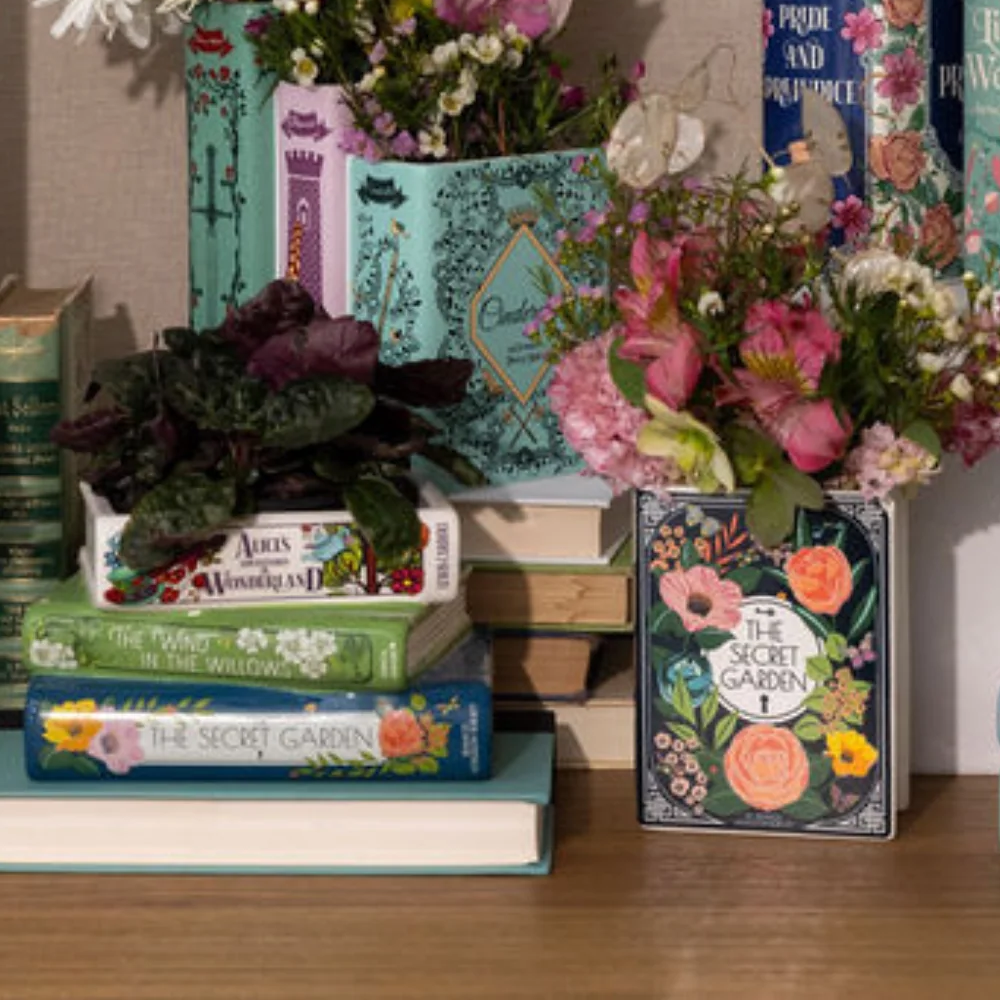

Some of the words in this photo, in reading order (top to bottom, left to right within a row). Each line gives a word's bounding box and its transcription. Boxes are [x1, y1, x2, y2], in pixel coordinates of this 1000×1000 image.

[778, 3, 832, 36] PRIDE
[784, 38, 825, 69] AND
[745, 619, 783, 642] THE
[141, 651, 158, 669] IN
[167, 653, 198, 673] THE
[729, 643, 800, 667] SECRET
[720, 667, 808, 693] GARDEN
[150, 721, 187, 749] THE
[199, 724, 271, 750] SECRET
[278, 726, 375, 750] GARDEN
